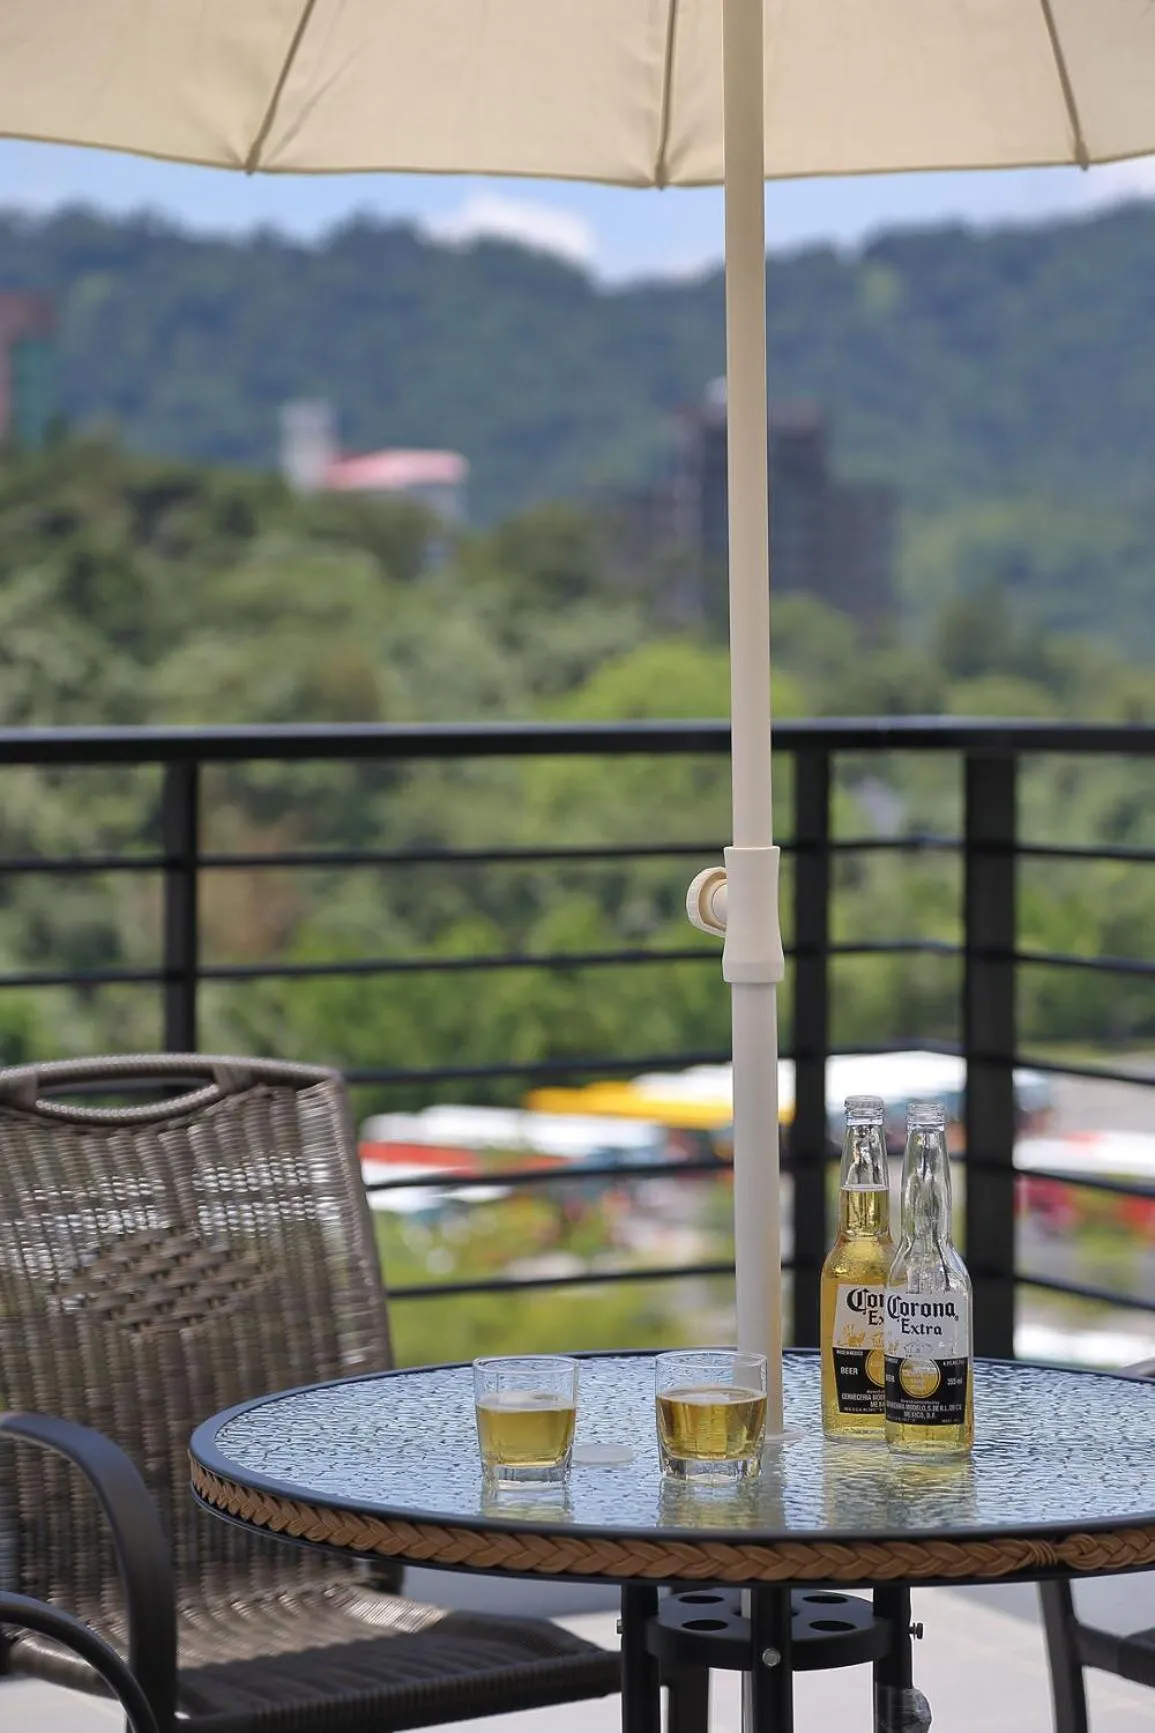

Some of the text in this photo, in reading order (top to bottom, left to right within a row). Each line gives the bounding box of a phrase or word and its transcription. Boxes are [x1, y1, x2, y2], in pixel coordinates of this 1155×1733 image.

[887, 1294, 956, 1321] Corona
[901, 1319, 942, 1335] Extra
[840, 1366, 858, 1376] BEER
